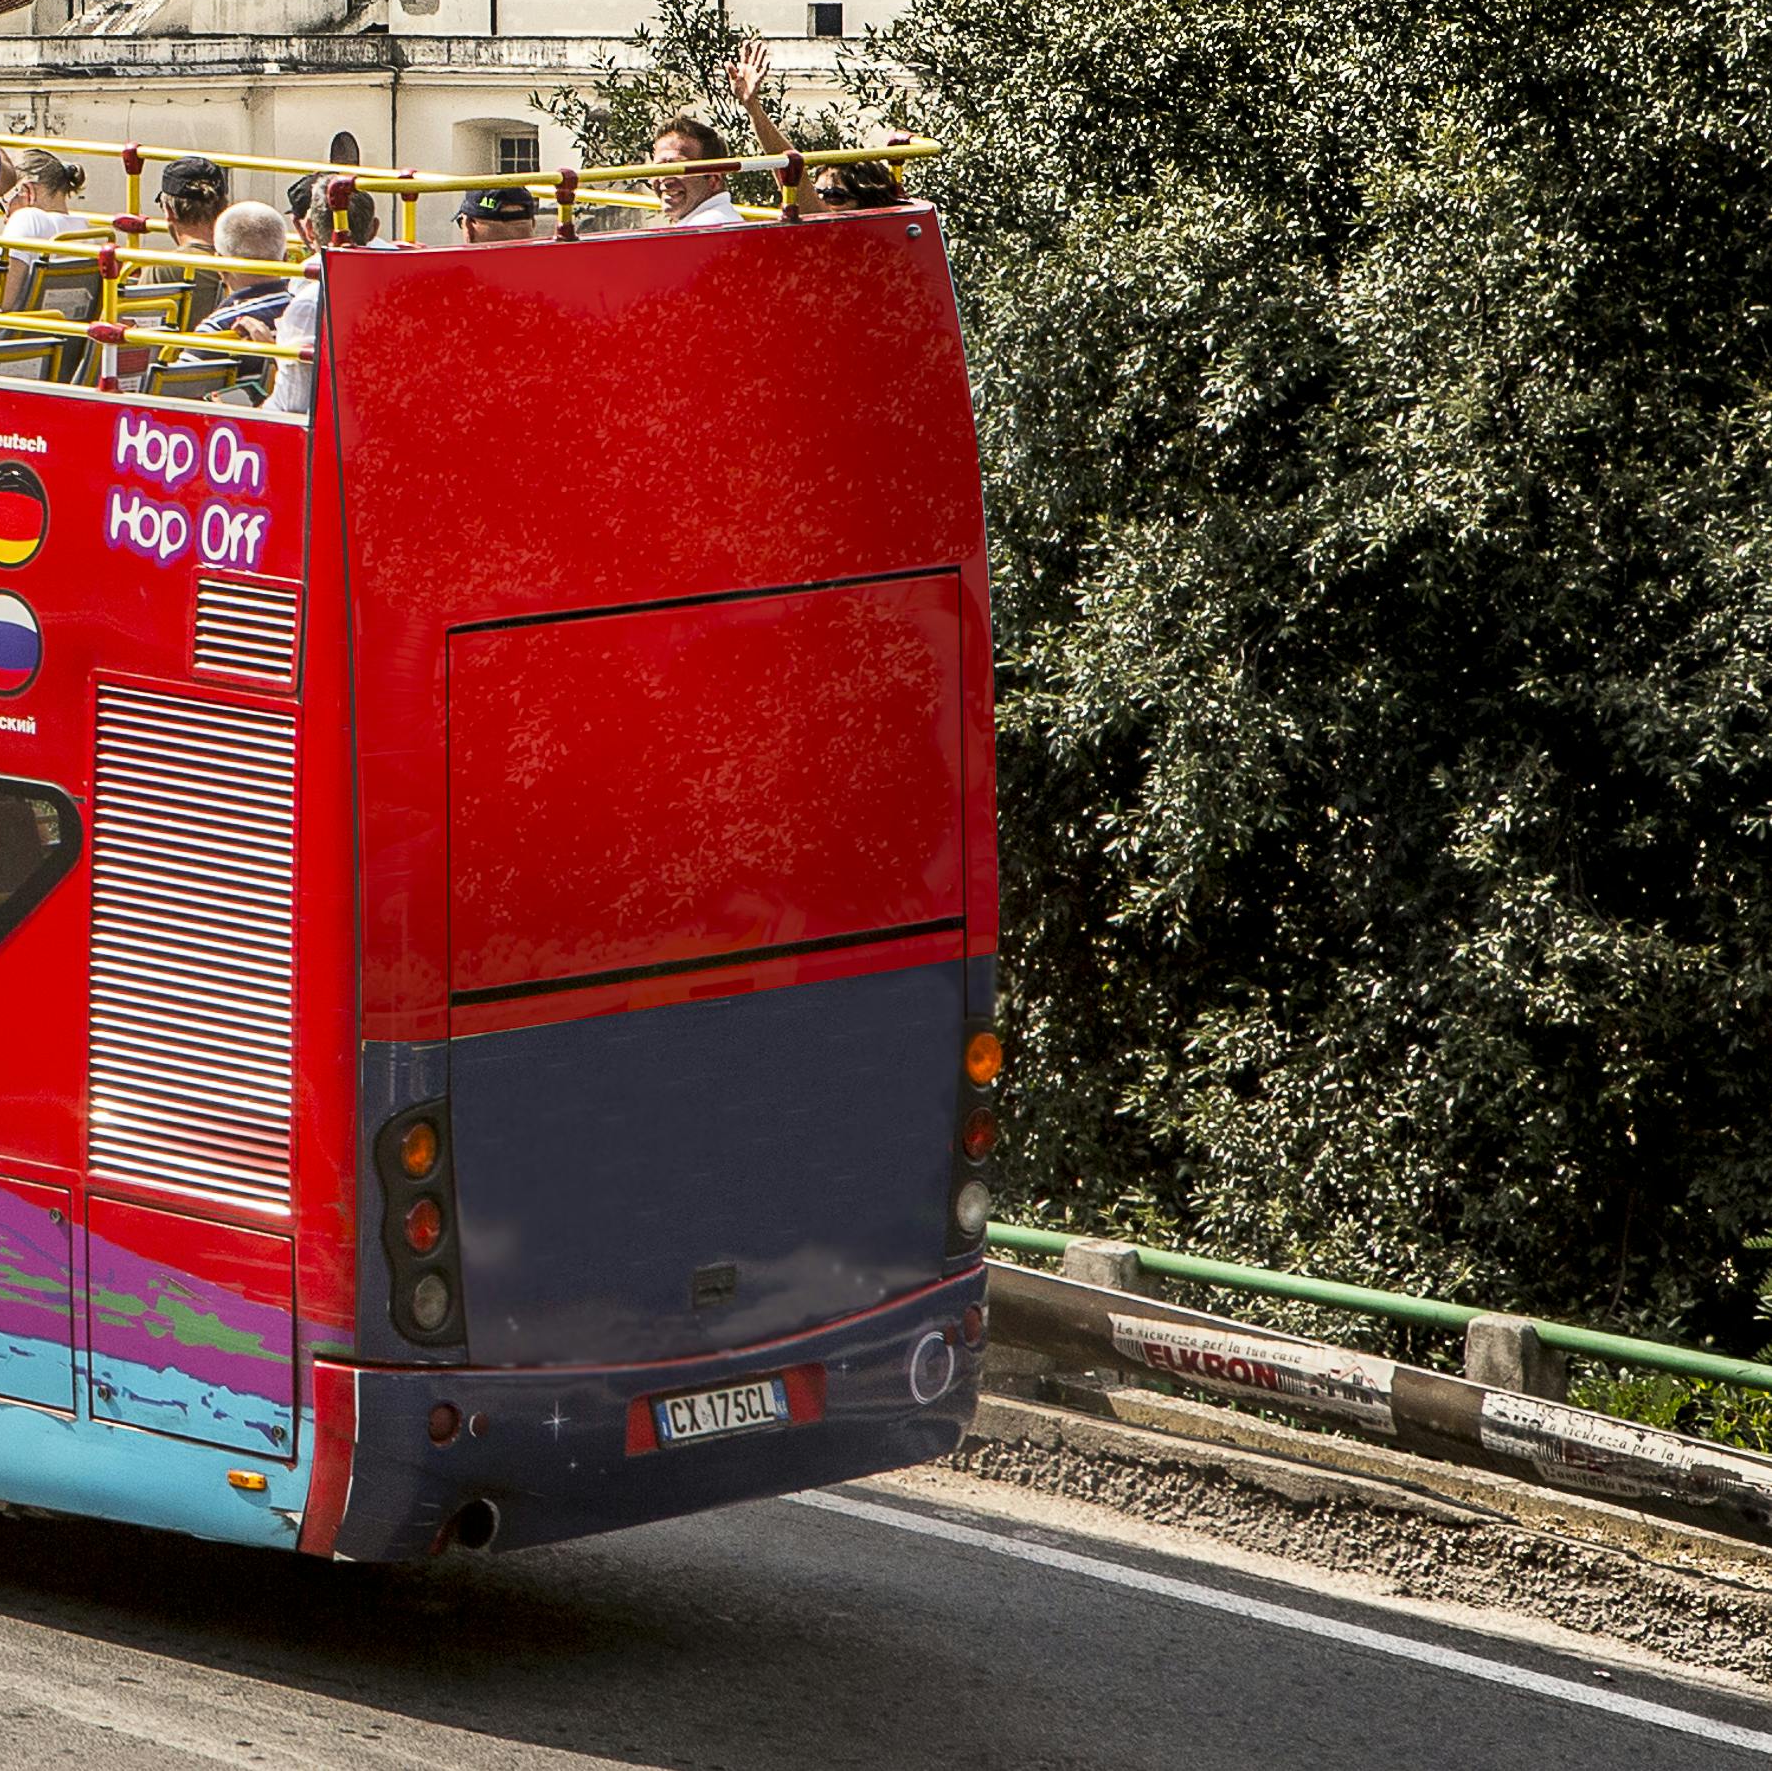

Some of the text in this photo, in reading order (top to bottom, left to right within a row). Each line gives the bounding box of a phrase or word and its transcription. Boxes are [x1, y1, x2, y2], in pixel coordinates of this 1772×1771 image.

[117, 415, 260, 488] Hop On
[110, 494, 262, 565] Hop Off
[1116, 1323, 1134, 1336] La
[1138, 1328, 1198, 1347] sicurezza
[1201, 1339, 1225, 1352] per
[1228, 1341, 1241, 1355] la
[1245, 1346, 1267, 1359] tua
[1142, 1341, 1279, 1390] ELKRON
[670, 1398, 702, 1434] CX
[707, 1385, 775, 1429] 175CL
[1562, 1424, 1627, 1450] sicurezza
[1632, 1441, 1656, 1457] per
[1661, 1445, 1675, 1462] la
